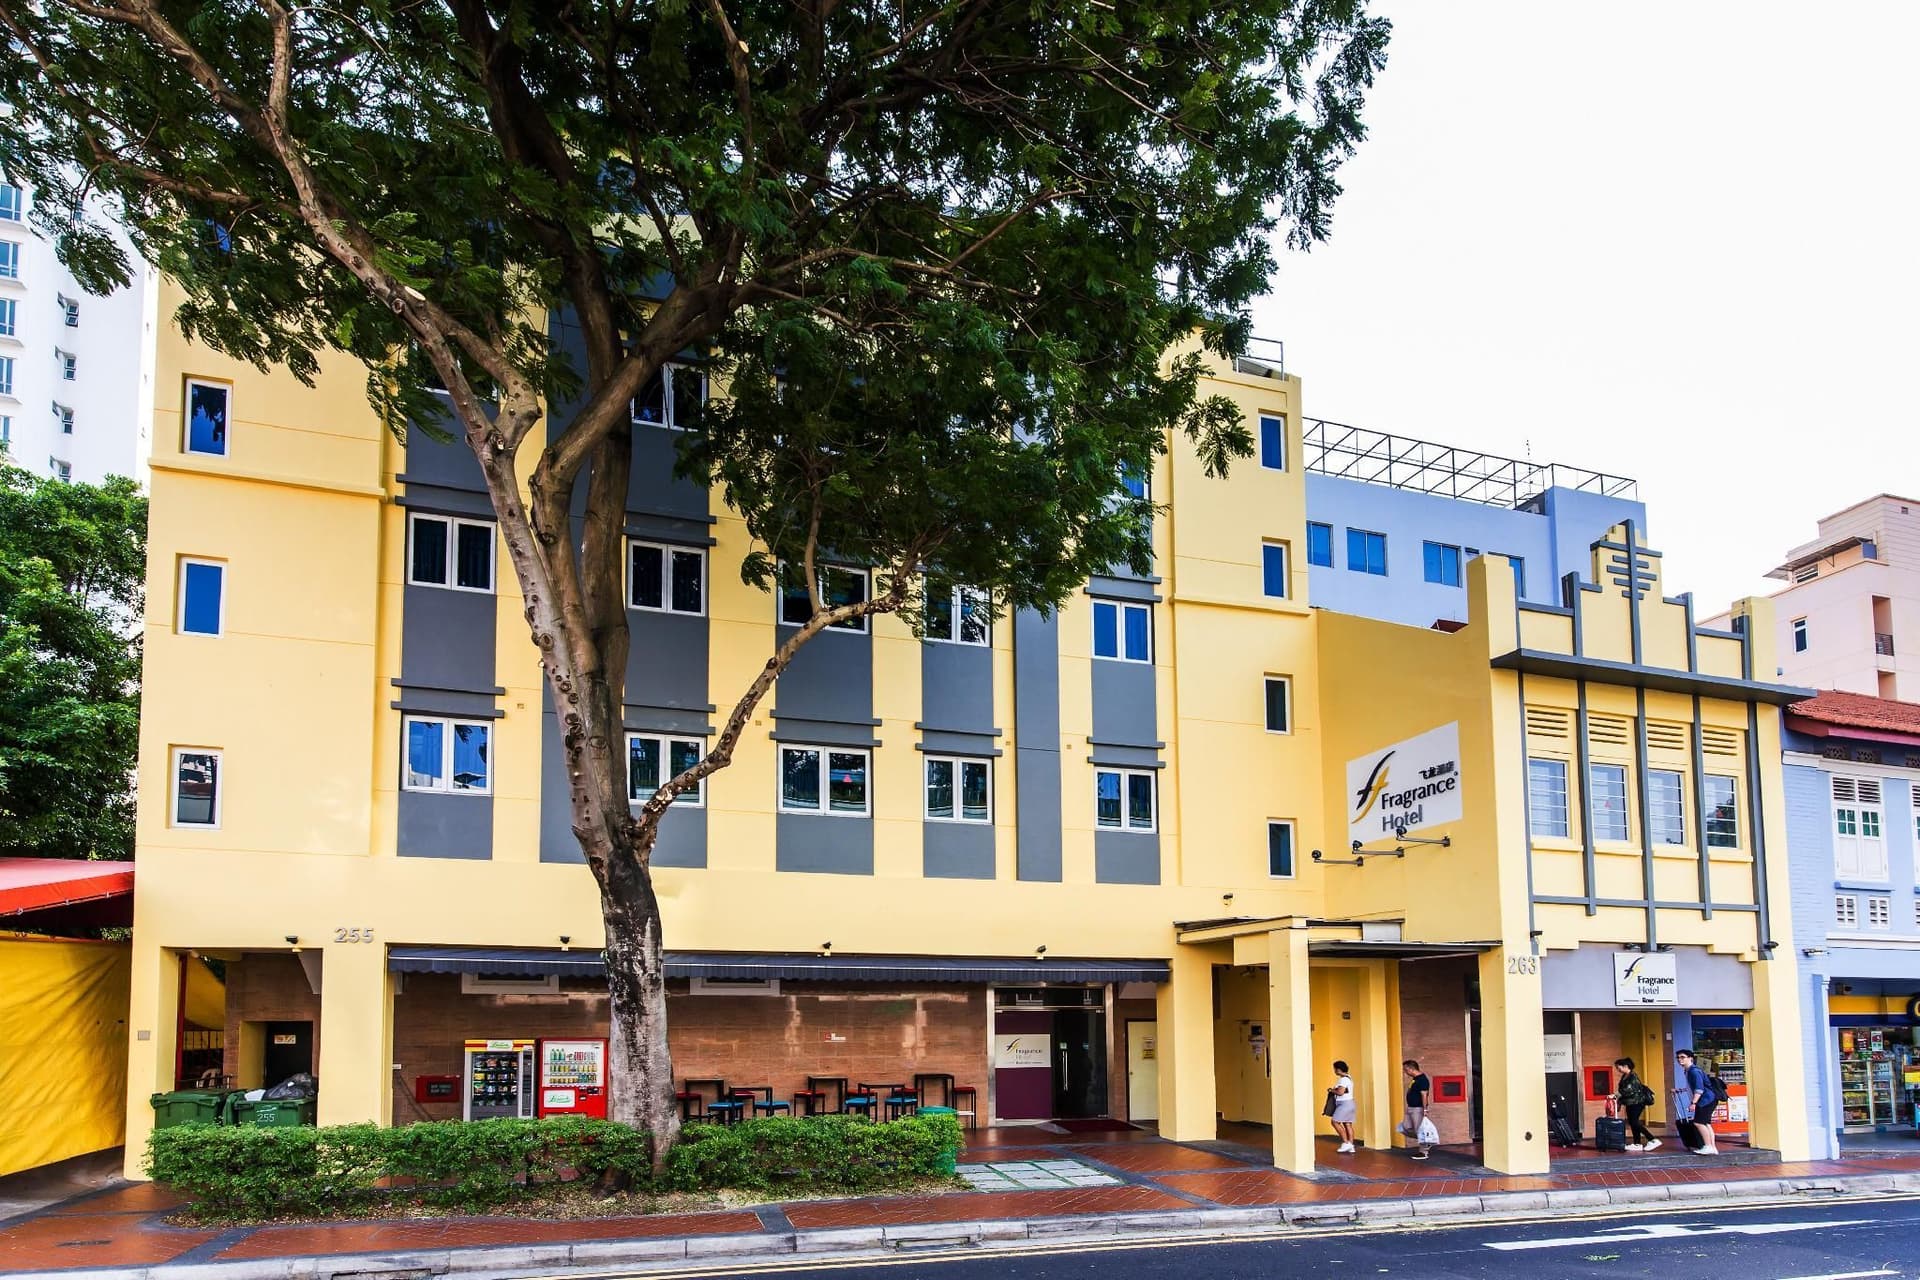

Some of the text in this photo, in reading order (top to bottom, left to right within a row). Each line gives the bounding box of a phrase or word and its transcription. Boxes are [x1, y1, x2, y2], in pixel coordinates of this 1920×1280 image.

[1381, 776, 1455, 810] Fragrance
[1382, 804, 1423, 832] Hotel
[333, 927, 375, 944] 255
[1508, 955, 1536, 975] 263
[1637, 975, 1675, 987] Fragrance
[1638, 986, 1660, 995] Hotel
[257, 1113, 276, 1123] 255
